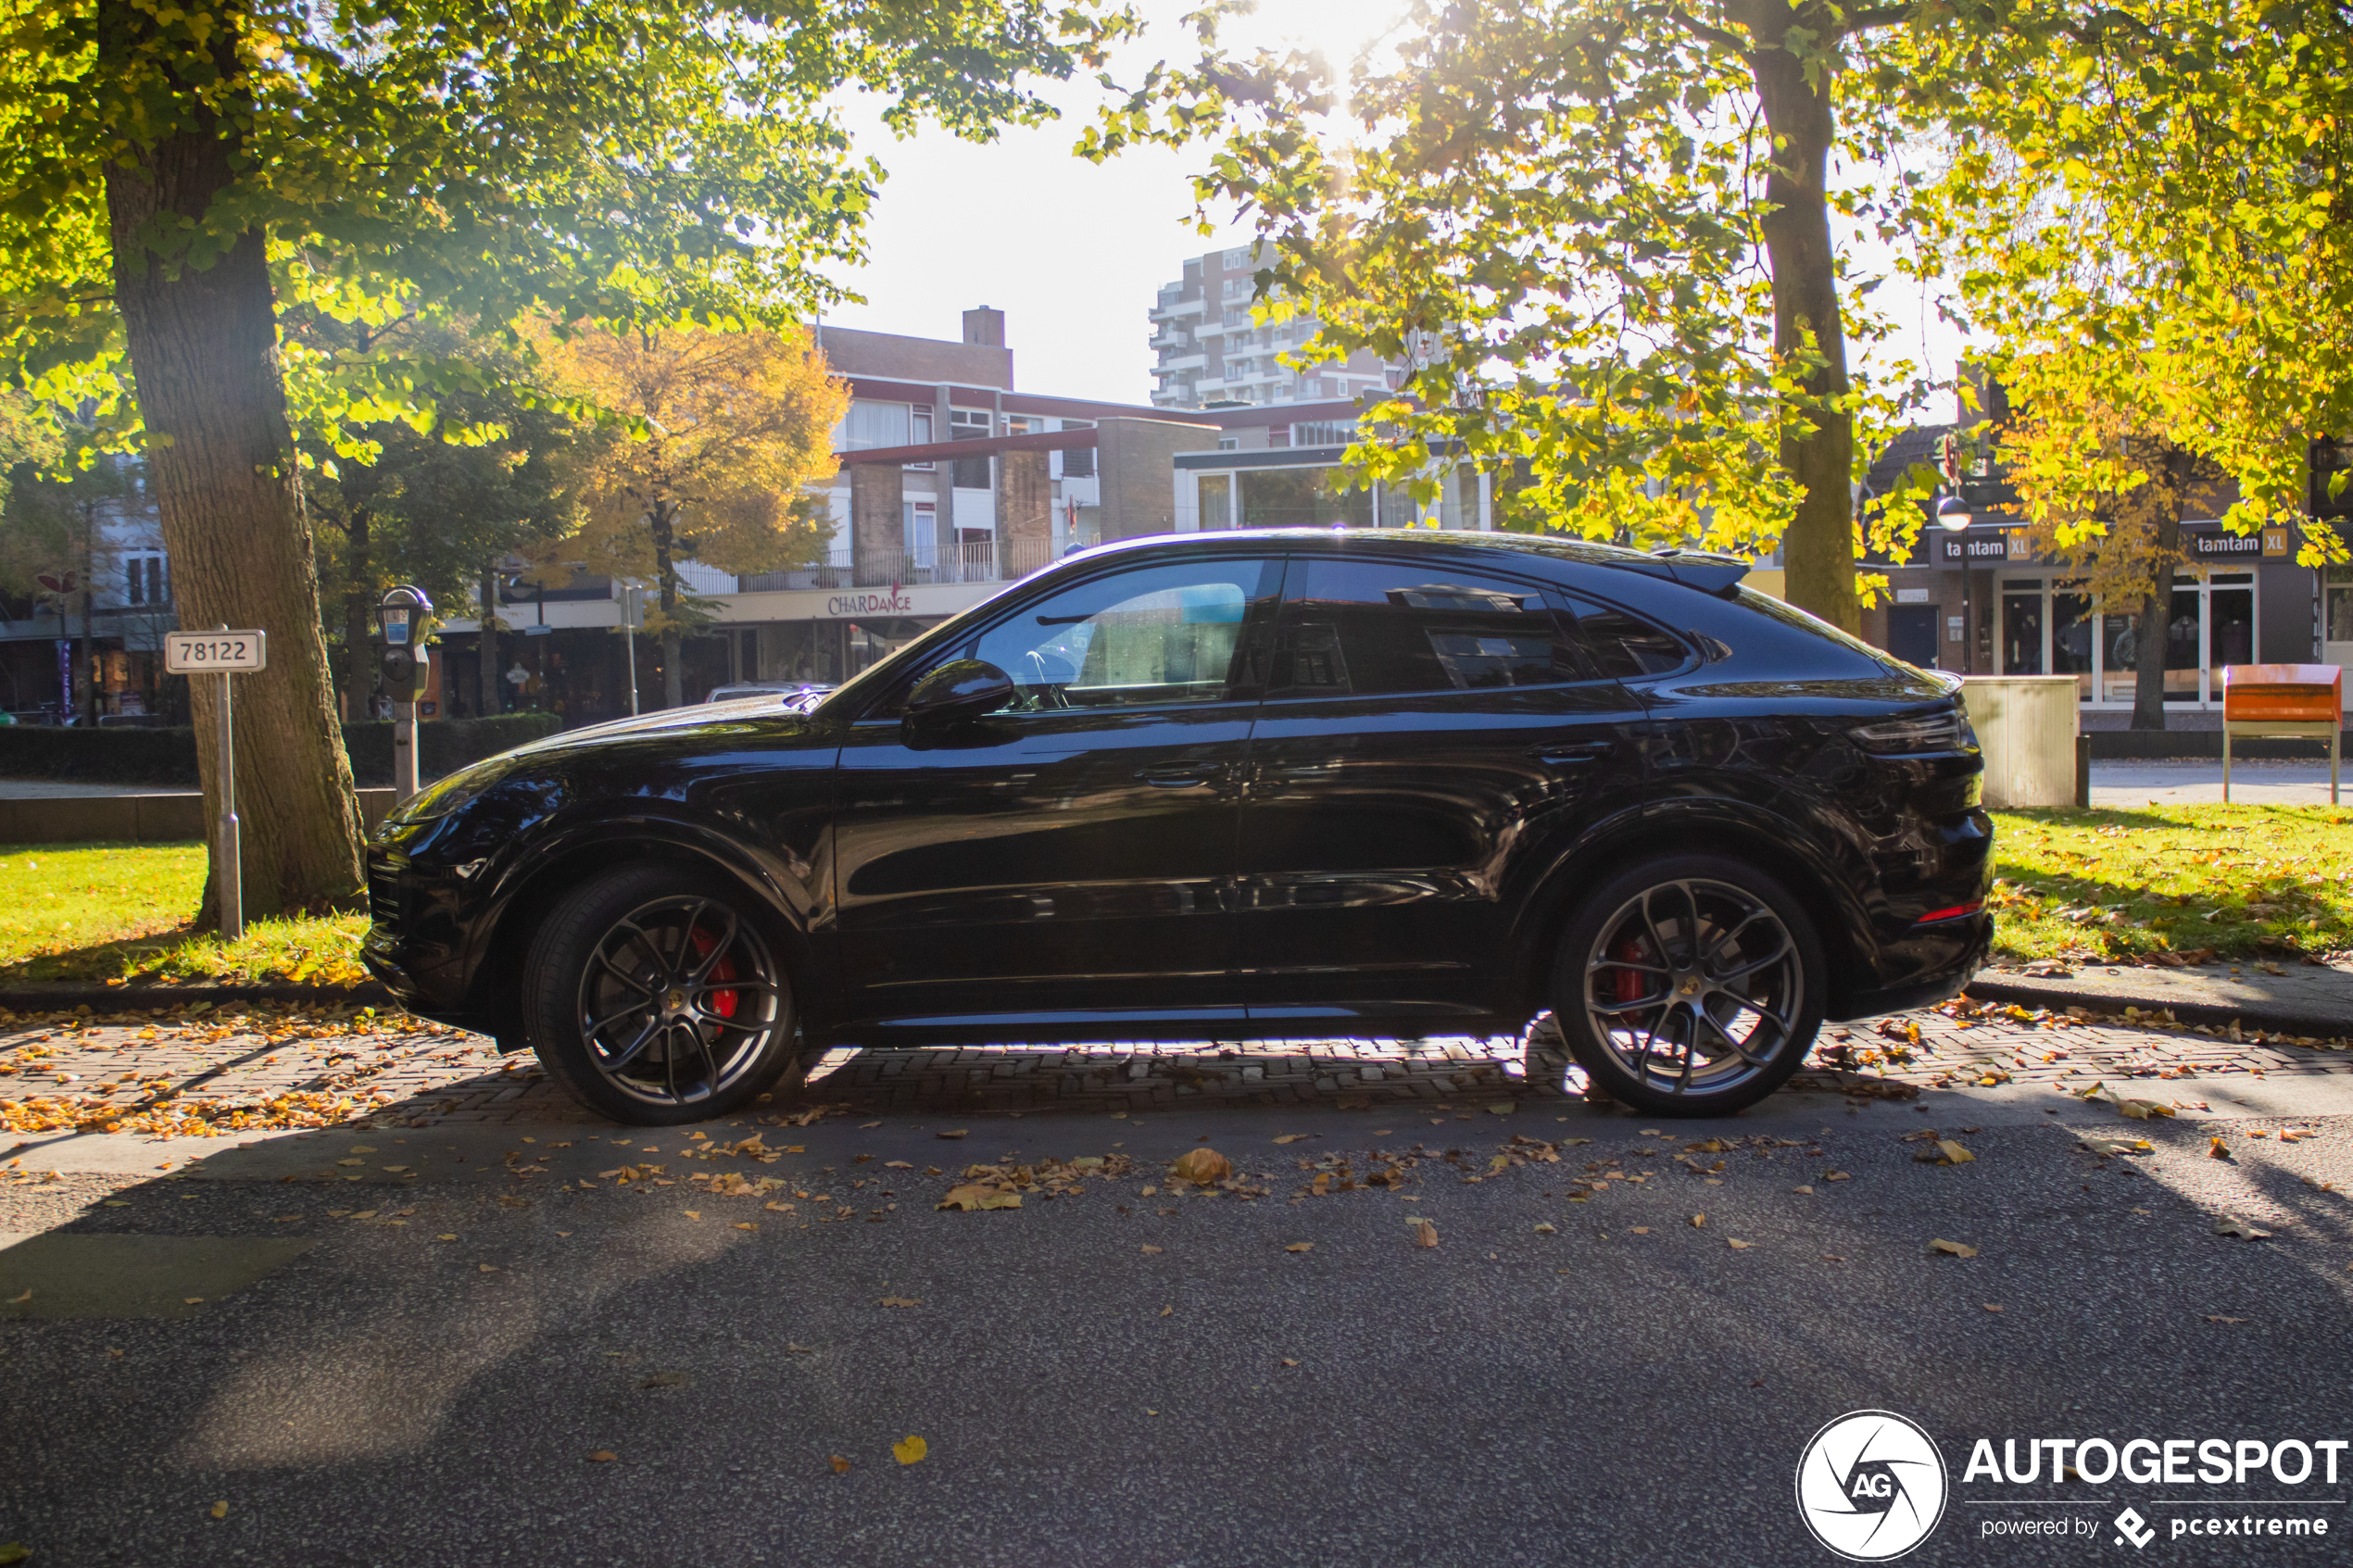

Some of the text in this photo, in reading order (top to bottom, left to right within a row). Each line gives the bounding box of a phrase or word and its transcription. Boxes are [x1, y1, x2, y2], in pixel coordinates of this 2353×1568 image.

[2011, 539, 2026, 554] XL
[2198, 535, 2284, 552] tamtam XL
[828, 595, 912, 616] CHARDANCE
[180, 642, 246, 661] 78122
